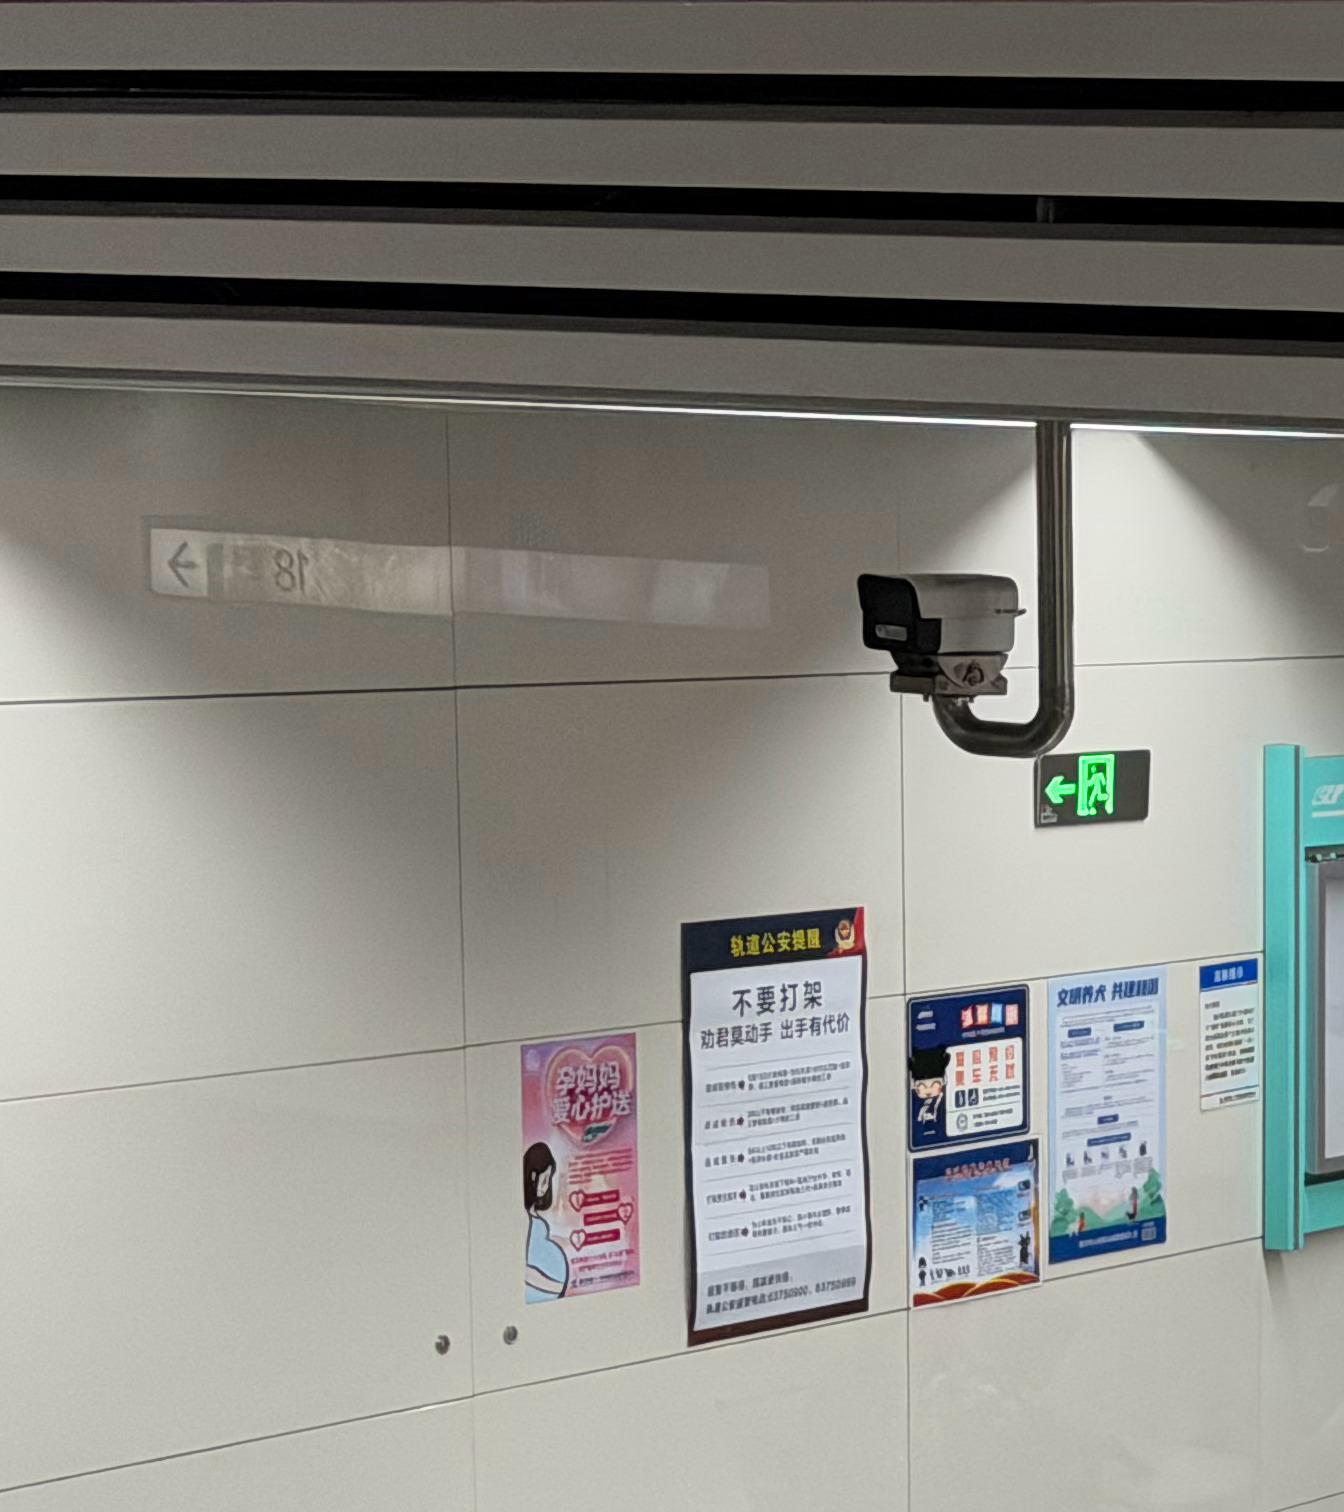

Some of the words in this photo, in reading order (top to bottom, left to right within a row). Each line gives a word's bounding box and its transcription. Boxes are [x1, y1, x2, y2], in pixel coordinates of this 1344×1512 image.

[730, 927, 822, 958] 轨道公安提醒
[732, 980, 823, 1018] 不要打架
[1057, 984, 1107, 1008] 文明养犬
[700, 1021, 773, 1050] 劝君莫动手
[780, 1012, 851, 1040] 出手有代价
[556, 1061, 621, 1096] 孕妈妈
[552, 1091, 633, 1125] 爱心护送
